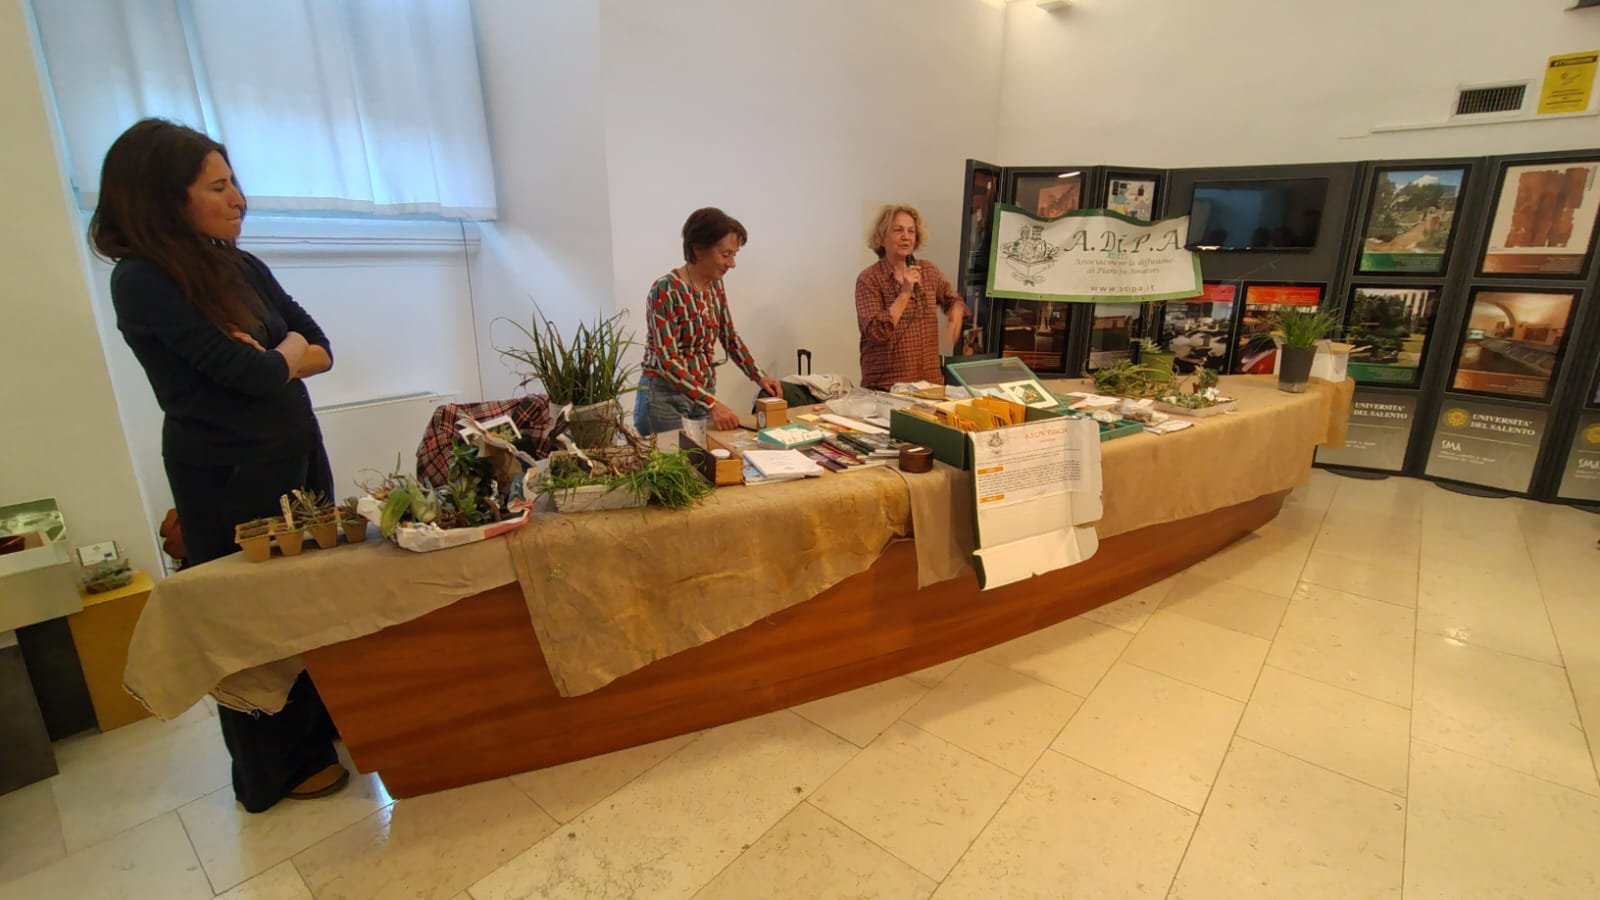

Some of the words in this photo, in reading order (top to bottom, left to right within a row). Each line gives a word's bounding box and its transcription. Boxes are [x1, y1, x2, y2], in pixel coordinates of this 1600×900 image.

[1370, 410, 1408, 419] SALENTO
[1470, 421, 1488, 430] DEL
[1490, 424, 1536, 436] SALENTO
